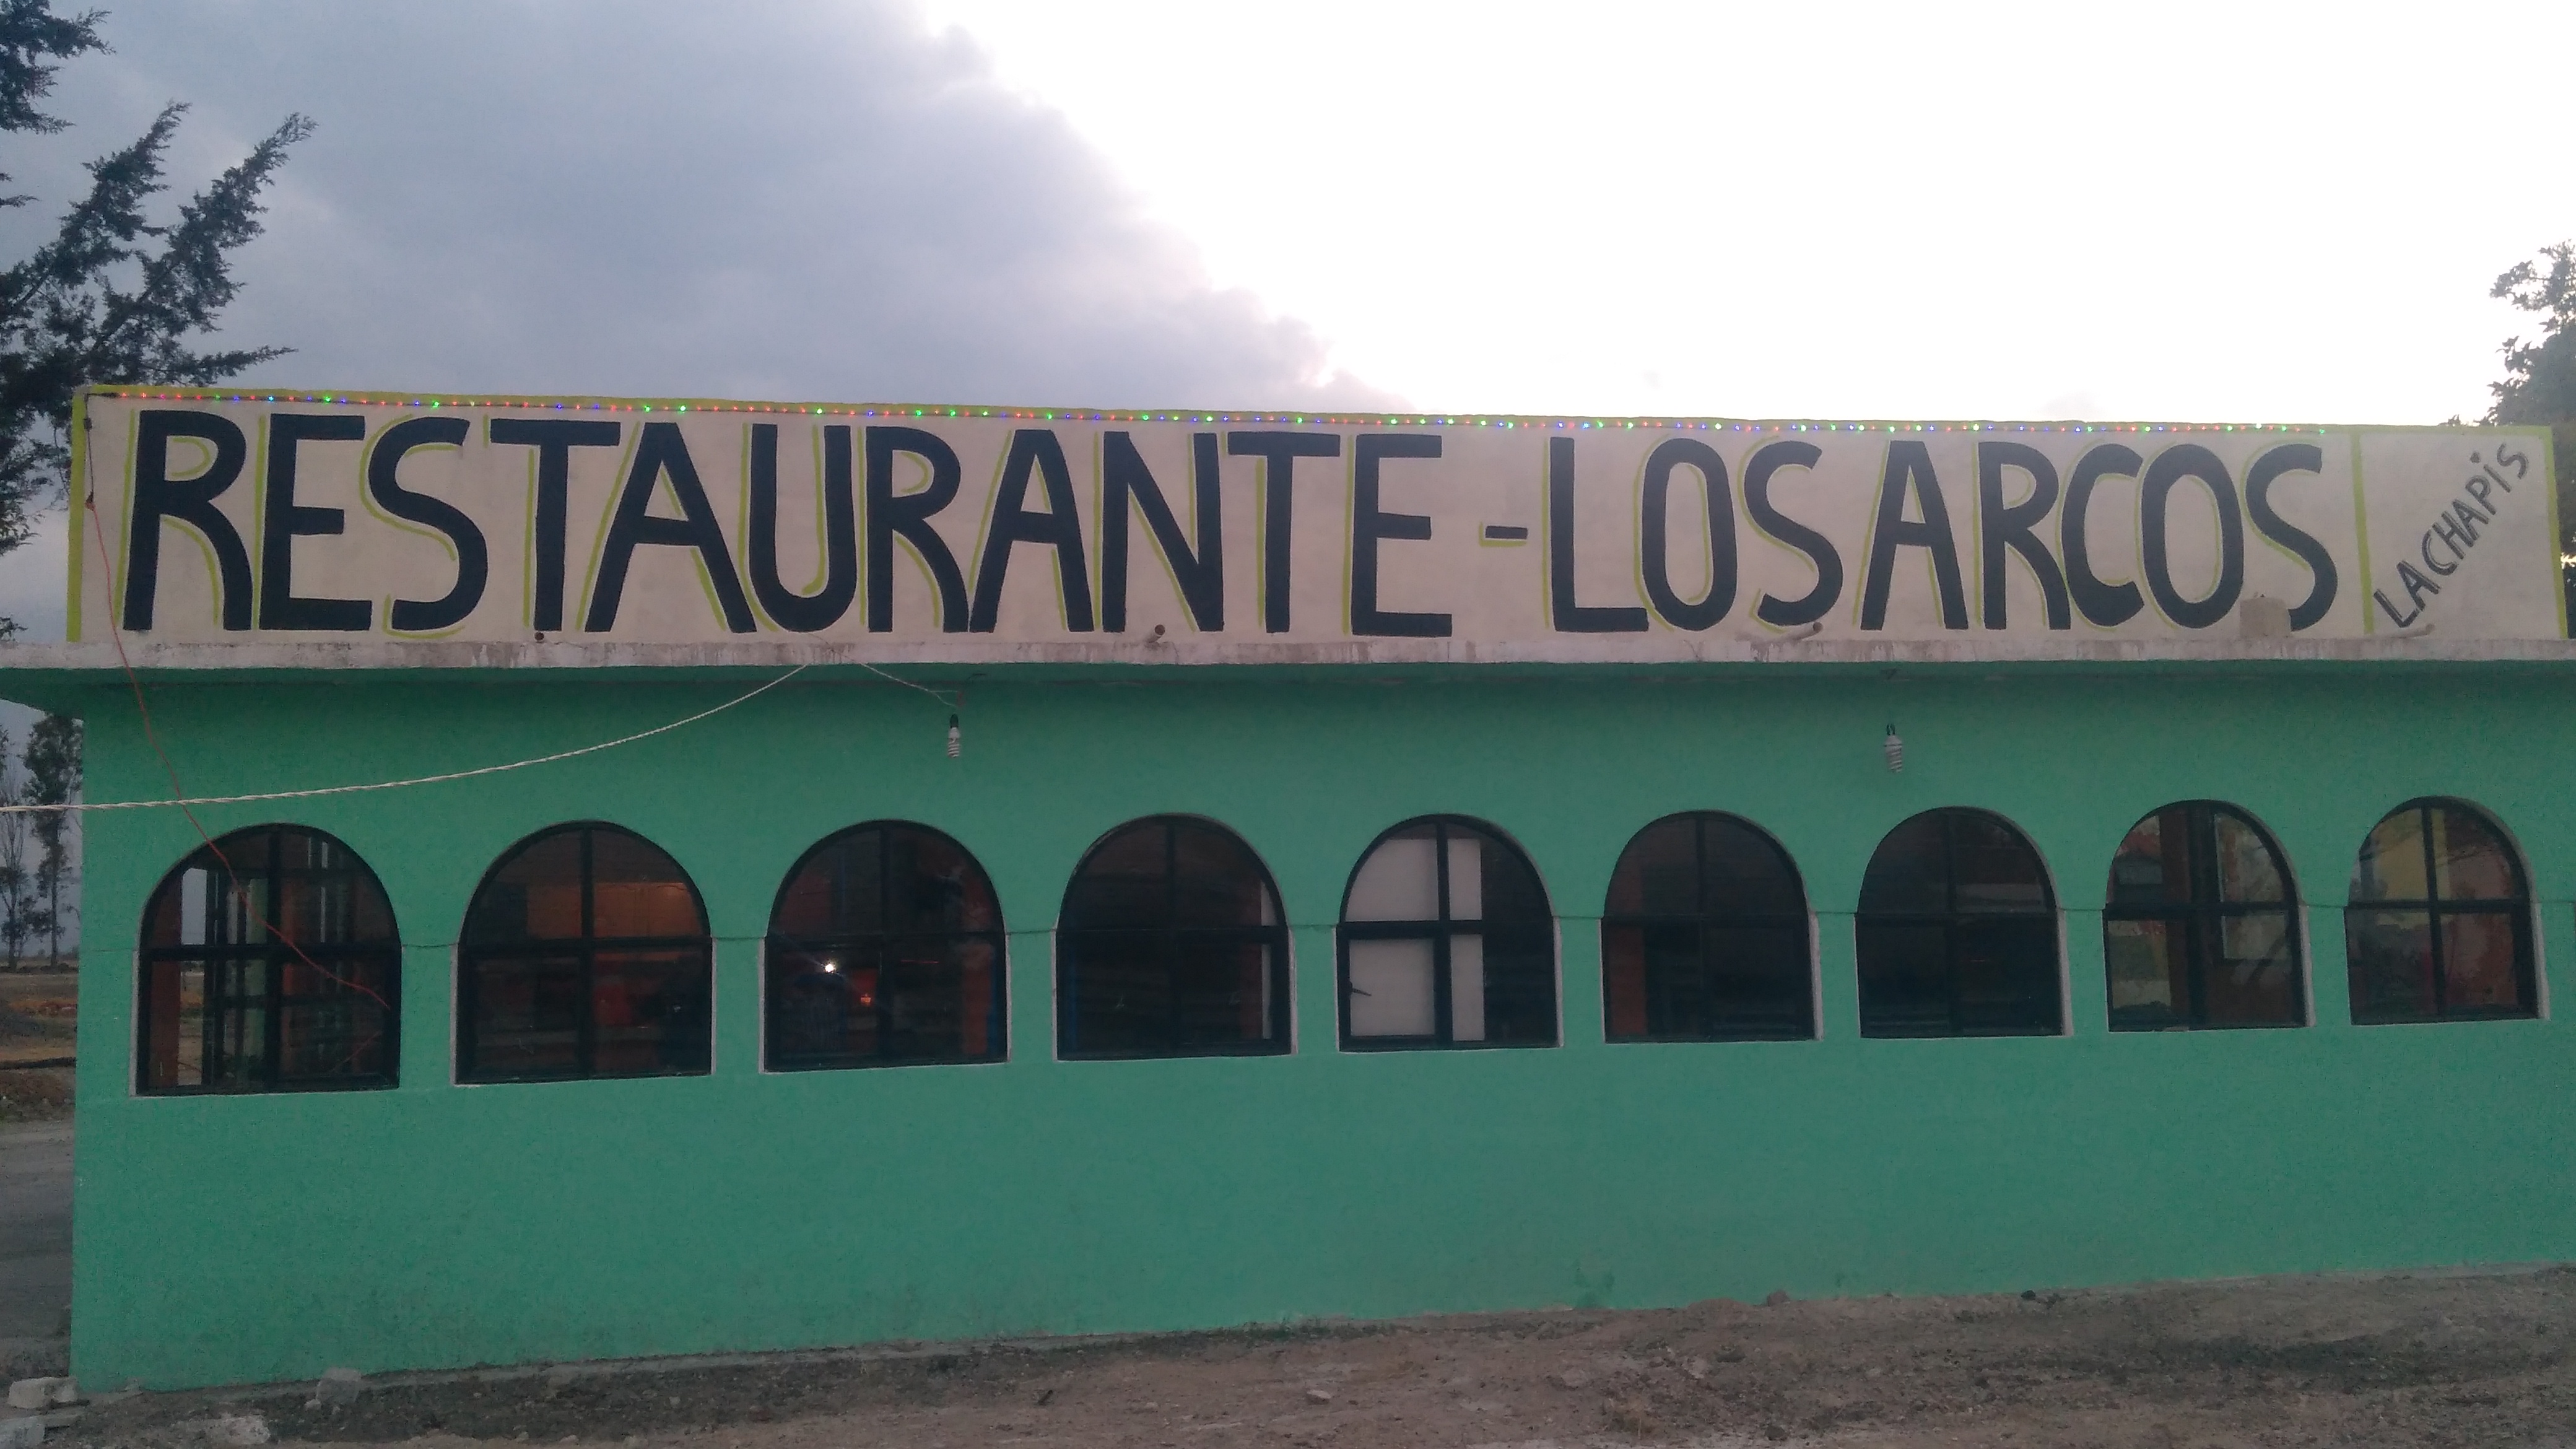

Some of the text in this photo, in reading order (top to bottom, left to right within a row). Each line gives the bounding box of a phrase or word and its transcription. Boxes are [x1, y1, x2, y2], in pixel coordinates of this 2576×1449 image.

[124, 409, 1453, 635] RESTAURANTE
[1549, 436, 1844, 632] LOS
[1860, 440, 2339, 632] ARCOS
